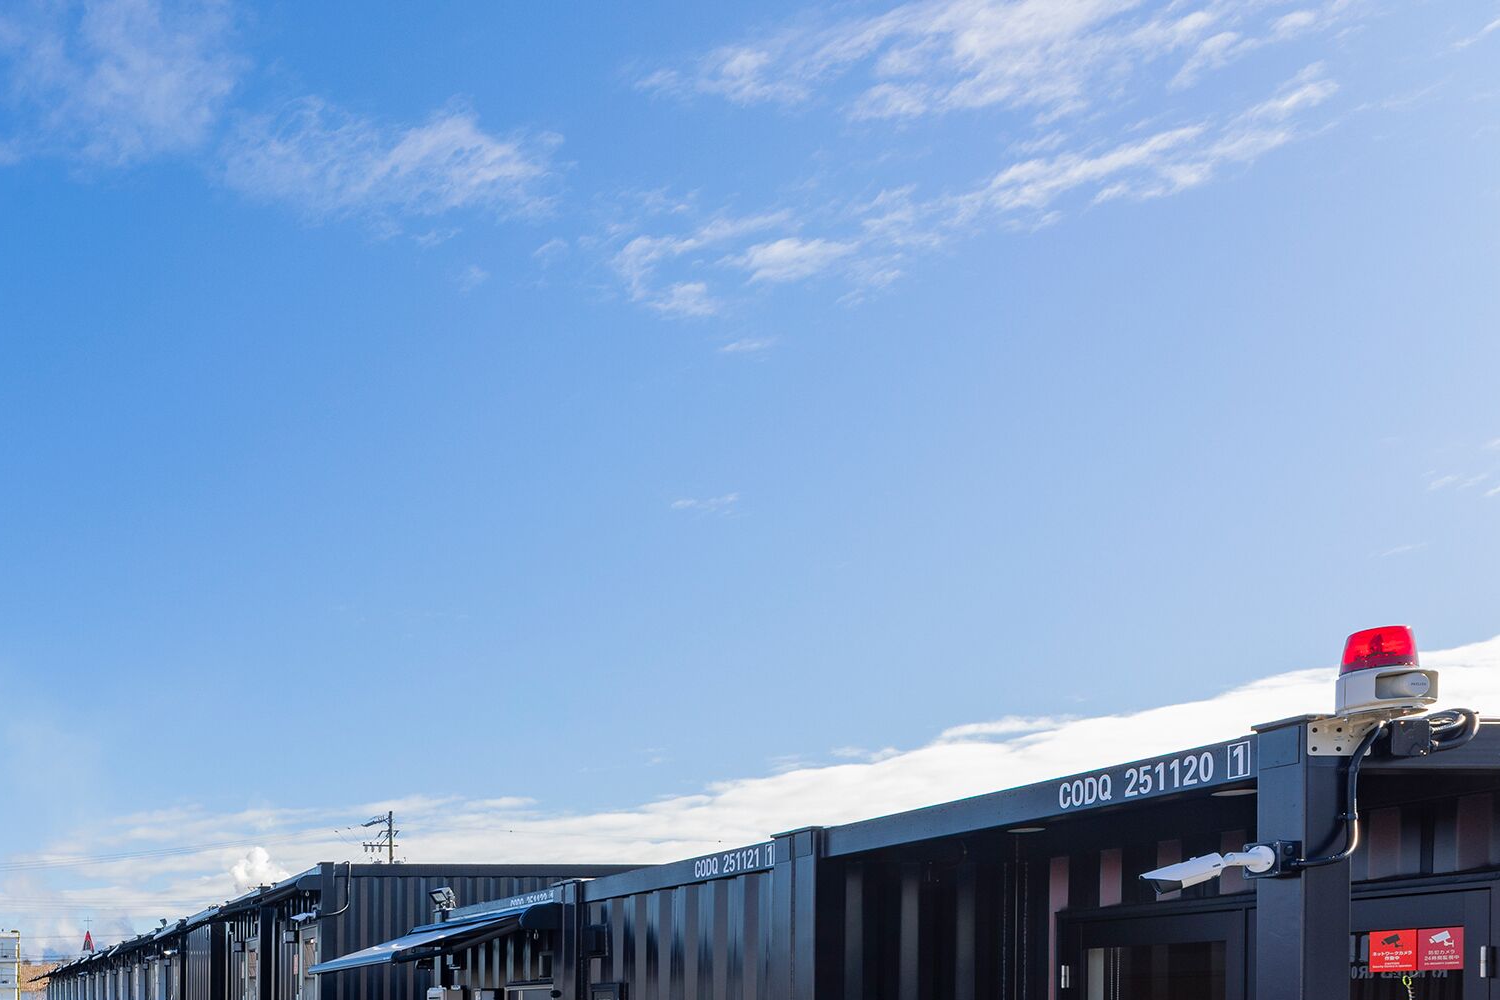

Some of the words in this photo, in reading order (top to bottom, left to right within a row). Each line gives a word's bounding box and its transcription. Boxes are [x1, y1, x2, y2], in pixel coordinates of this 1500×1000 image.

[1059, 774, 1112, 809] CODQ
[1124, 751, 1214, 798] 251120
[1231, 743, 1246, 777] 1
[694, 857, 718, 878] CODQ
[723, 848, 759, 874] 251121
[766, 844, 774, 866] 1
